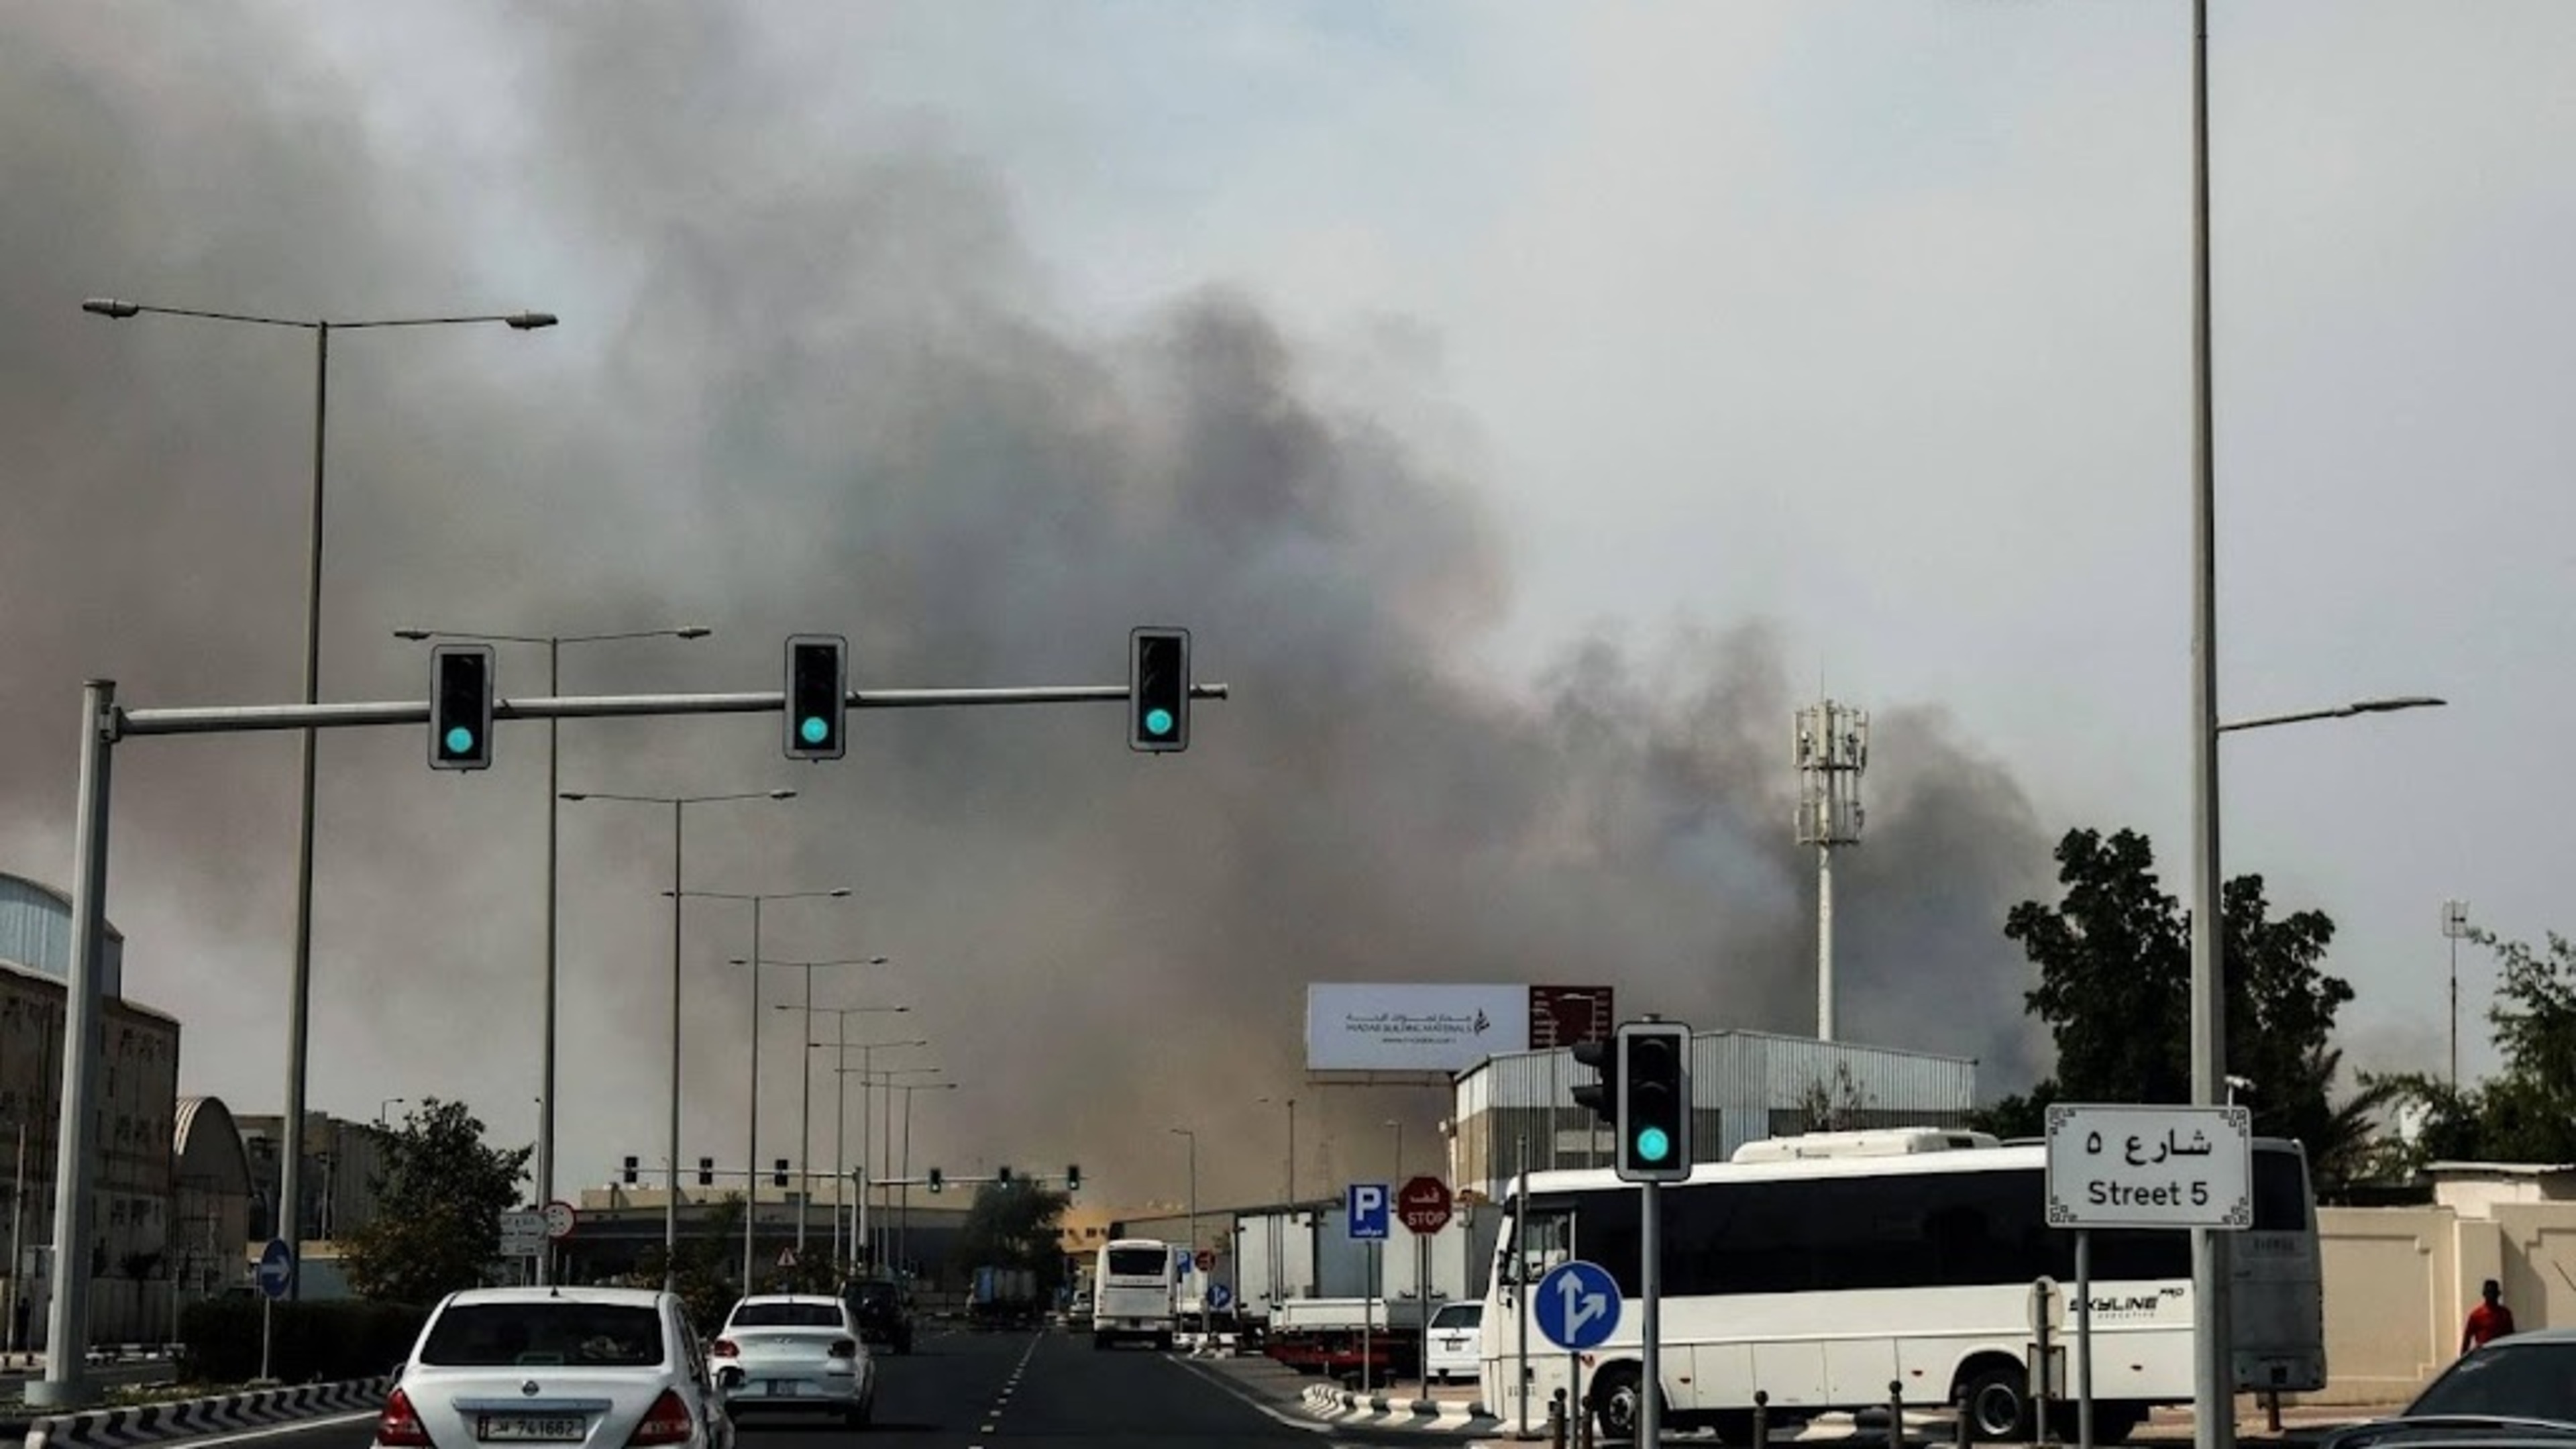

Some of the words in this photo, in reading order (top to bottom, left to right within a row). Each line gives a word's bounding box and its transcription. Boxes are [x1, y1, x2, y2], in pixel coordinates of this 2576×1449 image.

[2086, 1130, 2102, 1155] ٥
[2125, 1128, 2212, 1166] شارع
[1355, 1187, 1382, 1221] P
[2088, 1181, 2181, 1206] Street
[2191, 1181, 2208, 1206] 5
[1407, 1210, 1447, 1226] STOP
[2159, 1287, 2185, 1298] PRO
